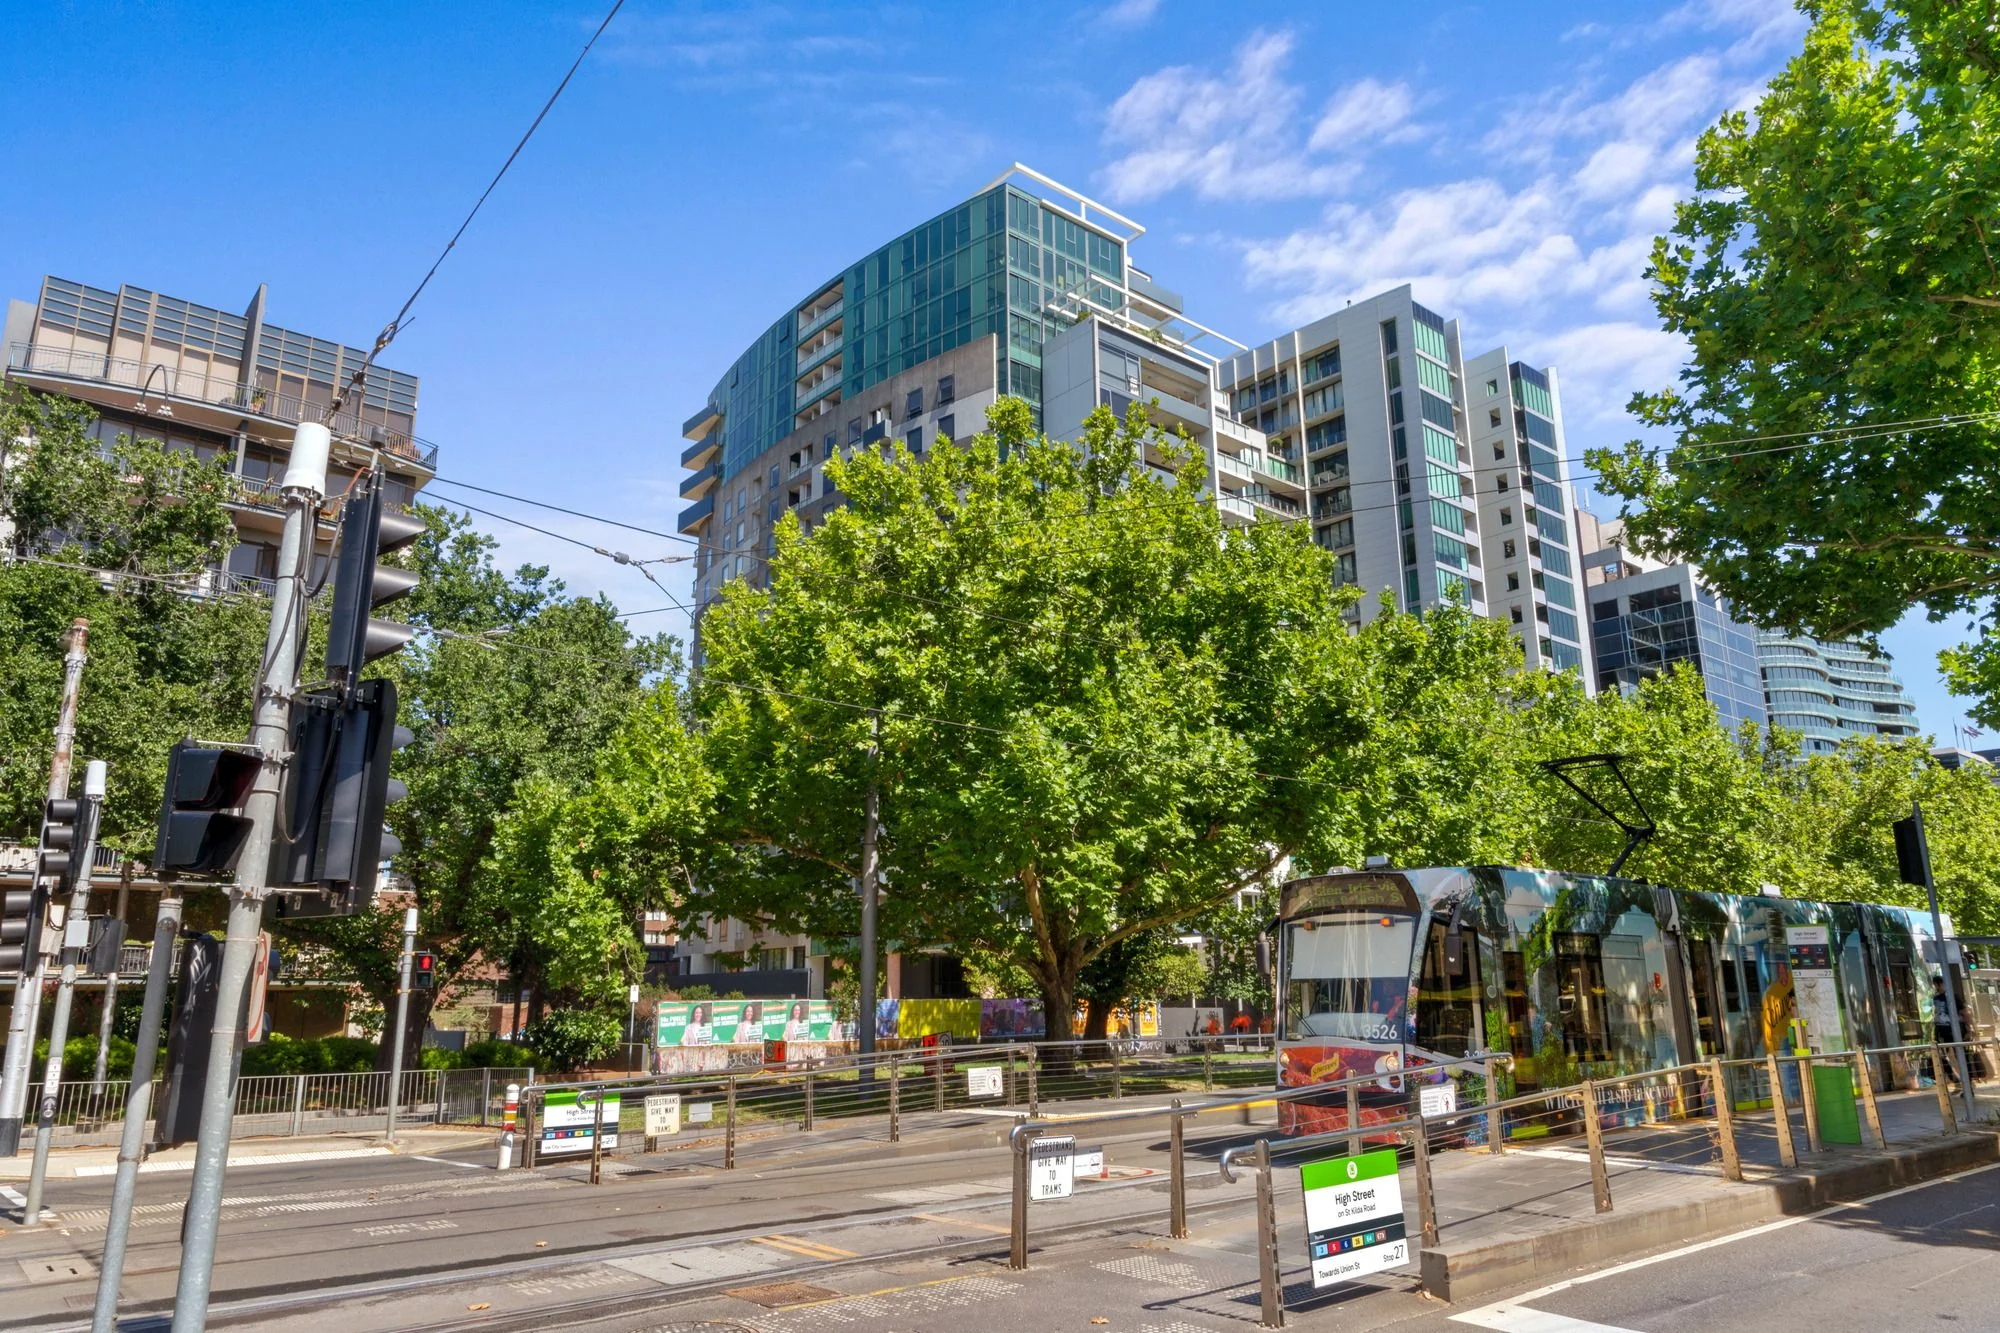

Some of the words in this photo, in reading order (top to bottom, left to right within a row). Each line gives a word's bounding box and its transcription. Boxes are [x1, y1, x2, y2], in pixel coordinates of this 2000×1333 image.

[1363, 1024, 1398, 1040] 3526
[648, 1097, 678, 1107] PEDESTRIANS
[1034, 1141, 1073, 1153] PEDESTRIANS
[1038, 1156, 1051, 1167] GIVE
[1055, 1154, 1067, 1166] WAY
[1049, 1169, 1056, 1180] TO
[1042, 1184, 1062, 1195] TRAMS
[1335, 1193, 1351, 1206] High
[1352, 1189, 1375, 1201] Street
[1345, 1208, 1351, 1216] St
[1351, 1206, 1363, 1215] Kilda
[1363, 1203, 1376, 1212] Road
[1383, 1254, 1394, 1262] Stop
[1394, 1245, 1404, 1259] 27
[1318, 1268, 1340, 1279] Towards
[1340, 1264, 1354, 1273] Union
[1354, 1261, 1360, 1270] St
